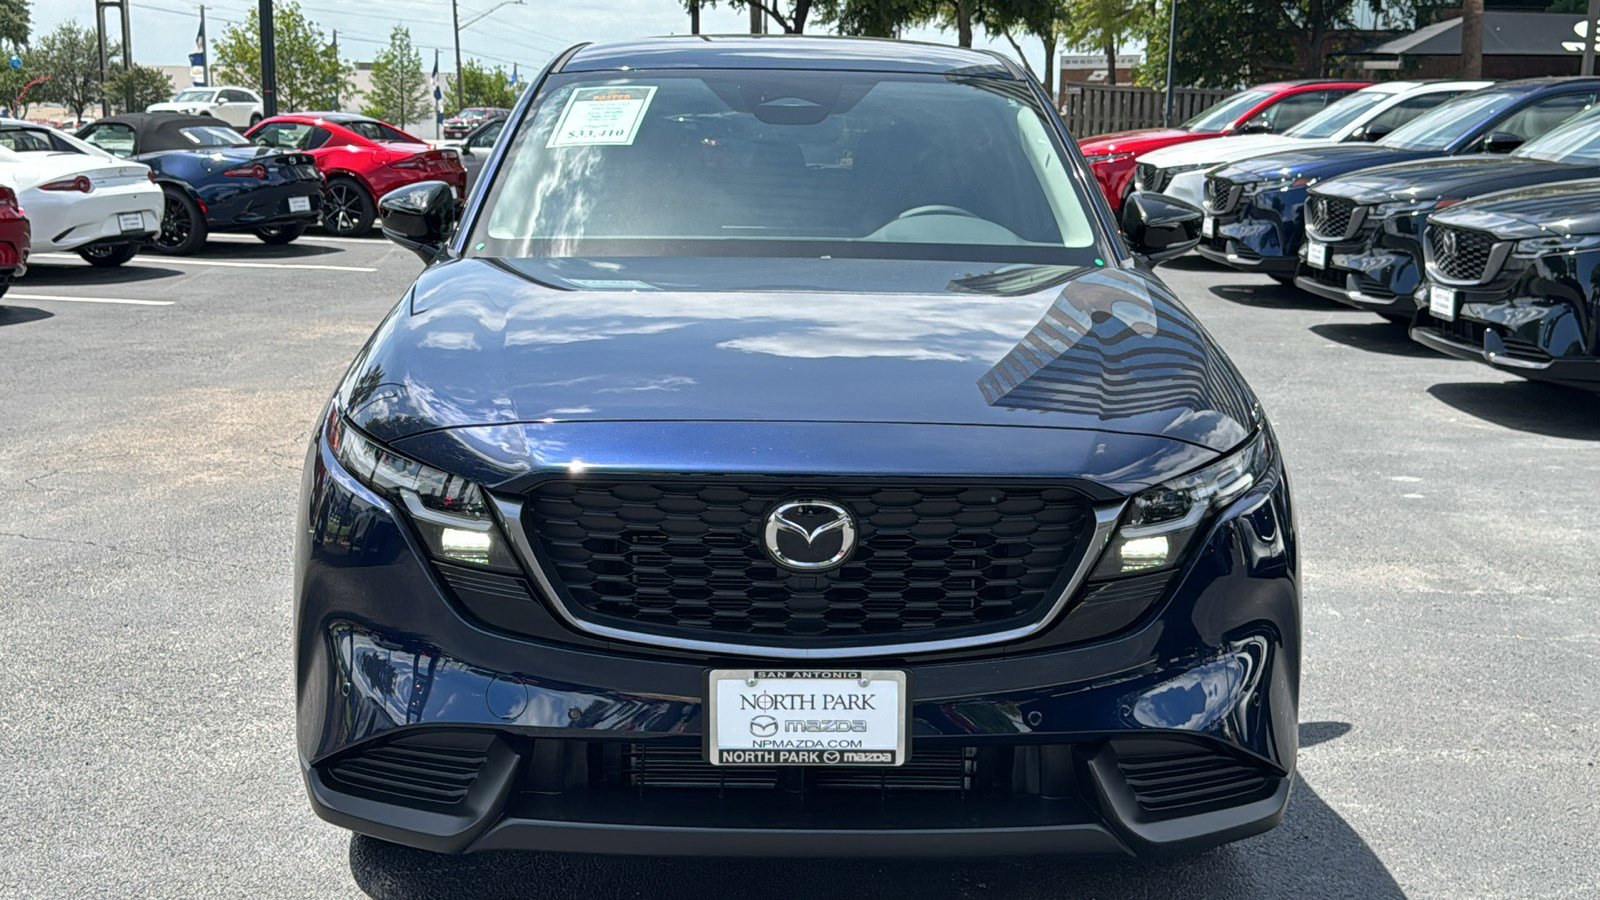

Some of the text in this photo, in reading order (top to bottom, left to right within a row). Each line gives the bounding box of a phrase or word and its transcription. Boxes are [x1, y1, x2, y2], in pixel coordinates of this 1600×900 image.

[757, 671, 859, 679] SAN ANTONIO
[740, 693, 876, 711] NORTH PARK
[784, 719, 867, 733] mazda
[752, 740, 862, 748] NPMAZDA.COM
[722, 751, 892, 763] NORTH PARK mazda
